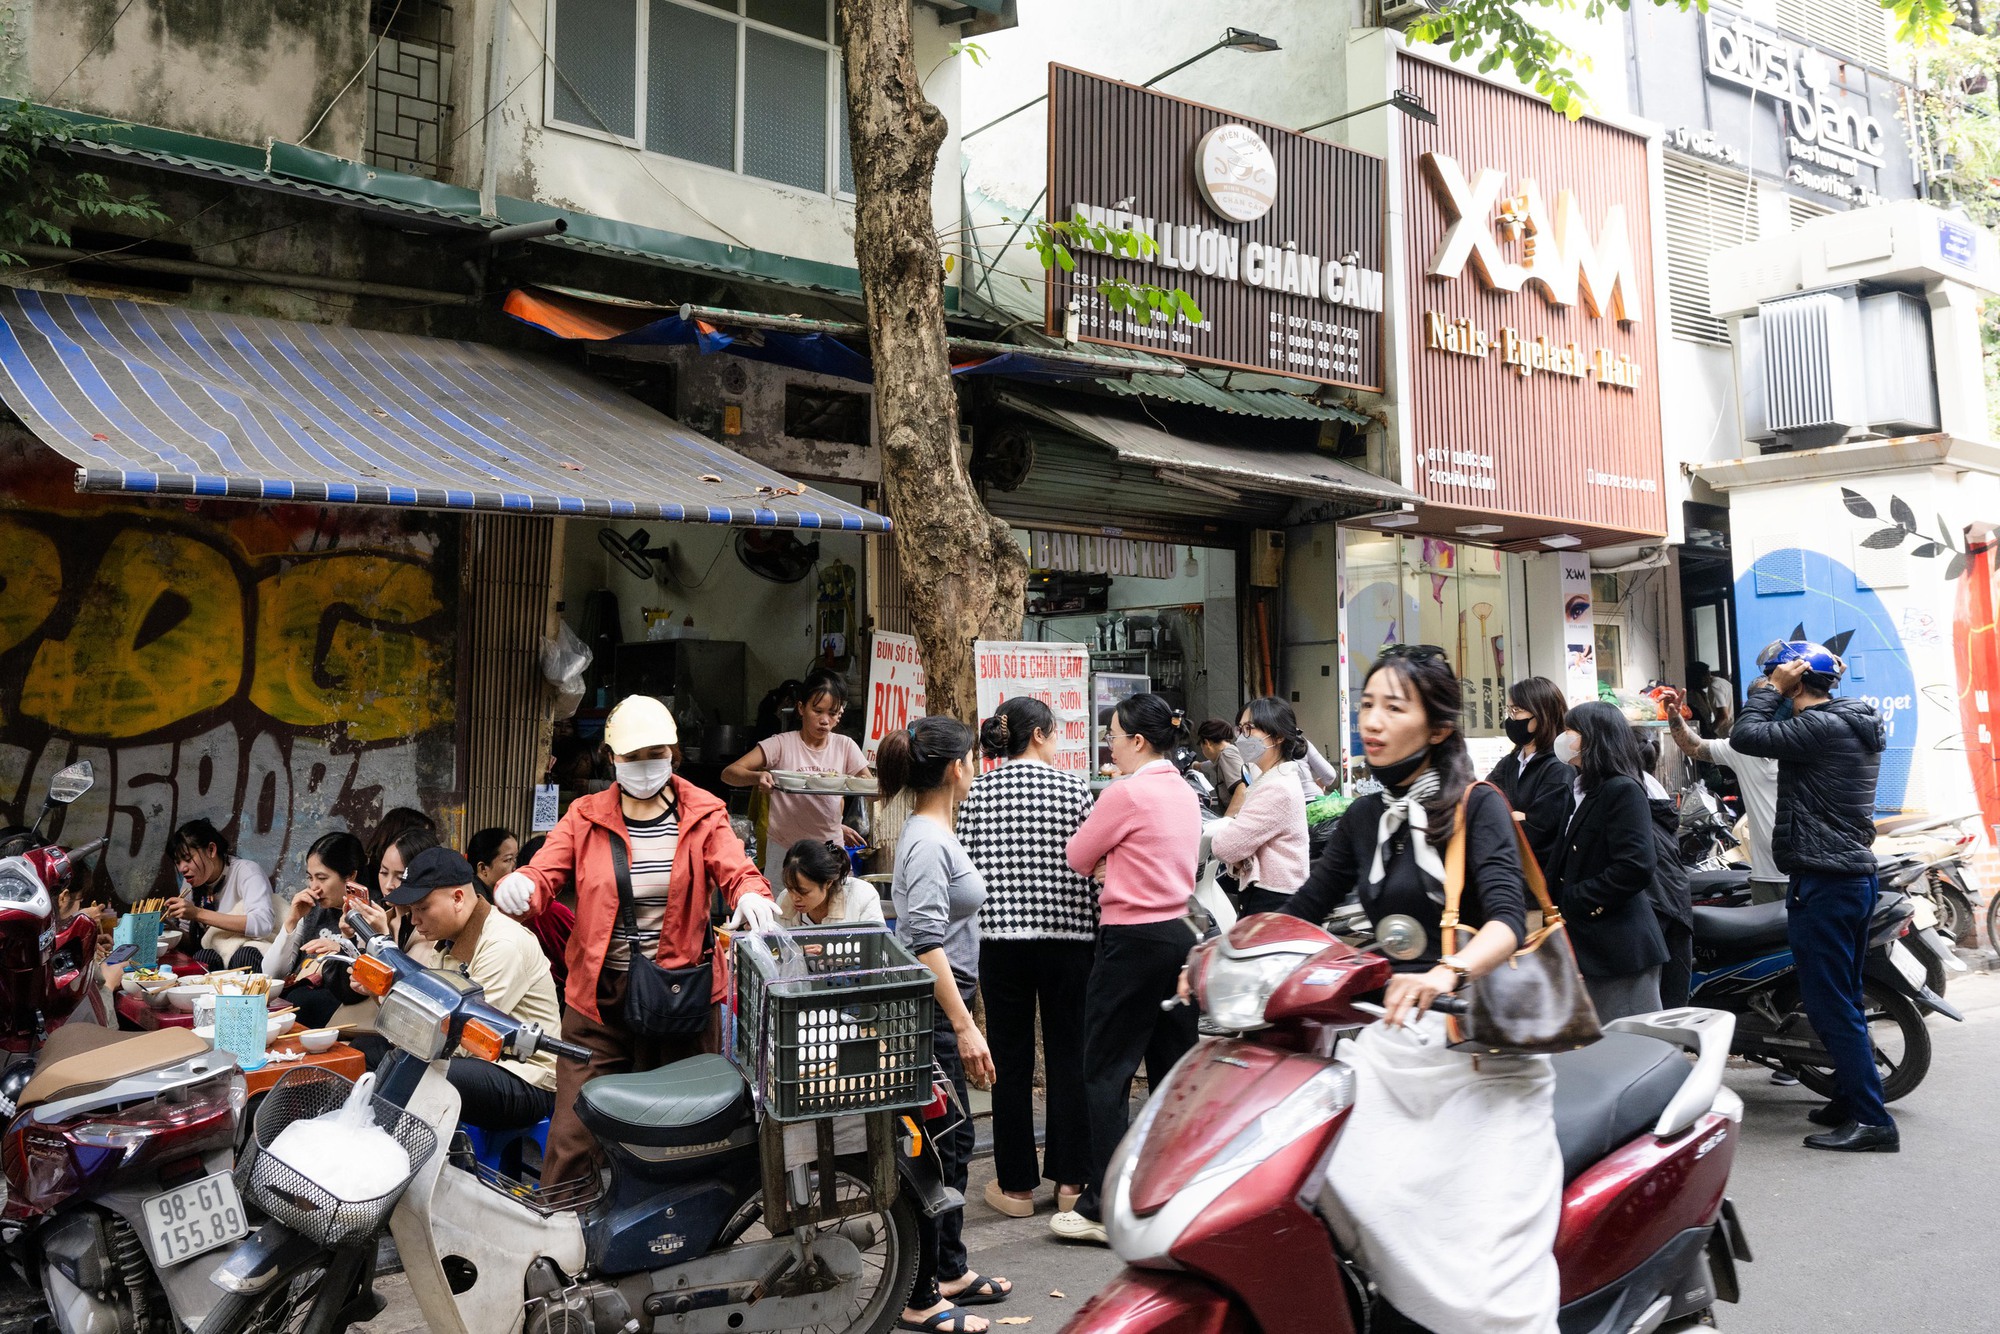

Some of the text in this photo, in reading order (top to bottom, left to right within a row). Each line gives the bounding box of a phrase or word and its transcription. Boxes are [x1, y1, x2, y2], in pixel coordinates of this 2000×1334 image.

[1071, 196, 1383, 313] MIẾN LƯƠN CHÂN CẦM
[1073, 272, 1089, 285] CS
[1108, 318, 1123, 332] 48
[1288, 315, 1307, 330] 037
[1311, 320, 1323, 333] 55
[1325, 323, 1338, 336] 33
[1341, 326, 1359, 341] 725
[1288, 334, 1314, 350] 0986
[1317, 340, 1330, 353] 48
[1332, 344, 1345, 356] 48
[1348, 347, 1359, 359] 41
[1426, 310, 1489, 358] Nails
[1501, 326, 1586, 377] Eyelash
[1596, 346, 1642, 389] Hair
[1288, 351, 1314, 367] 0869
[1317, 357, 1330, 370] 48
[1332, 360, 1345, 373] 48
[1348, 363, 1359, 375] 41
[876, 638, 893, 661] BÚN
[895, 641, 906, 663] SỐ
[907, 647, 913, 664] 6
[979, 649, 1002, 679] BÚN
[1004, 646, 1018, 679] SỐ
[1020, 655, 1026, 679] 6
[1029, 650, 1057, 679] CHÂN
[871, 666, 910, 741] BÚN
[1882, 694, 1912, 722] get
[1065, 721, 1085, 744] MỌC
[168, 1100, 209, 1117] HONDA
[664, 1138, 731, 1156] HONDA
[159, 1179, 224, 1226] 98-G1
[160, 1207, 240, 1260] 155.89
[650, 1241, 684, 1252] CUB
